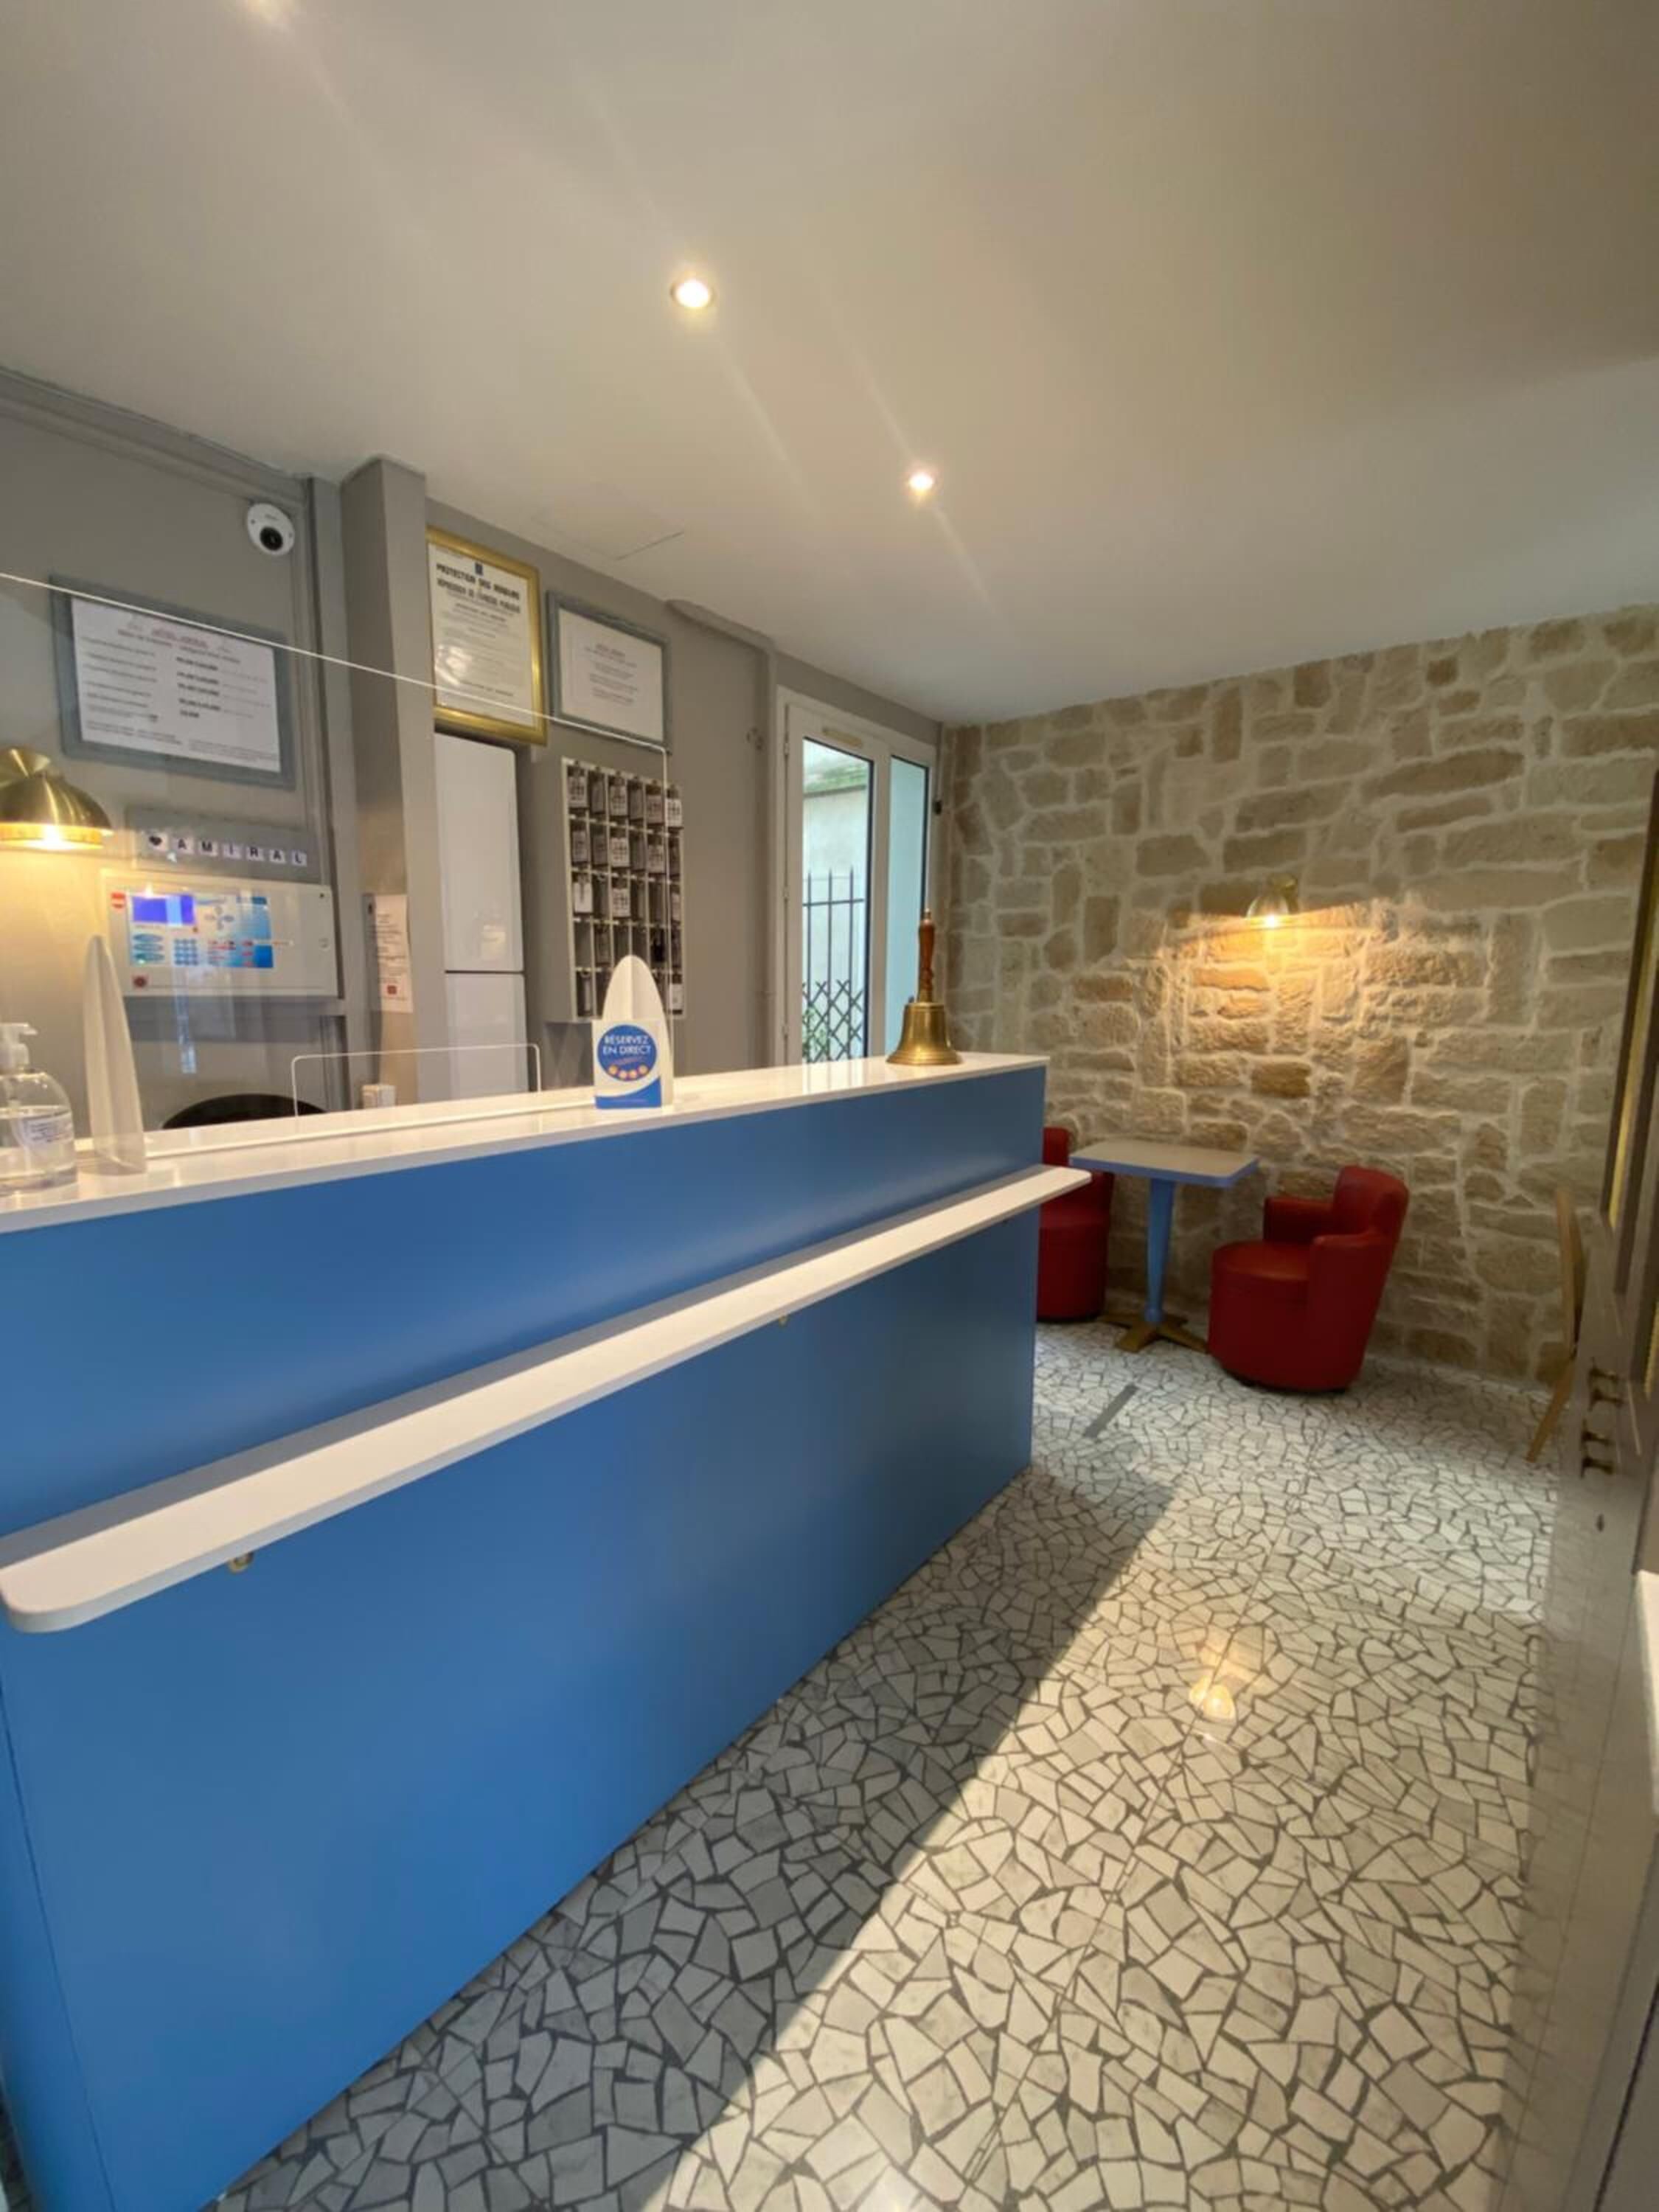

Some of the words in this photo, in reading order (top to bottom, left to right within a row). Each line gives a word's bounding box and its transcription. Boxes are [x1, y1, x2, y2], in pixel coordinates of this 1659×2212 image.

[177, 838, 302, 863] AMIRAL
[602, 1046, 617, 1055] EN
[619, 1045, 651, 1054] DIRECT
